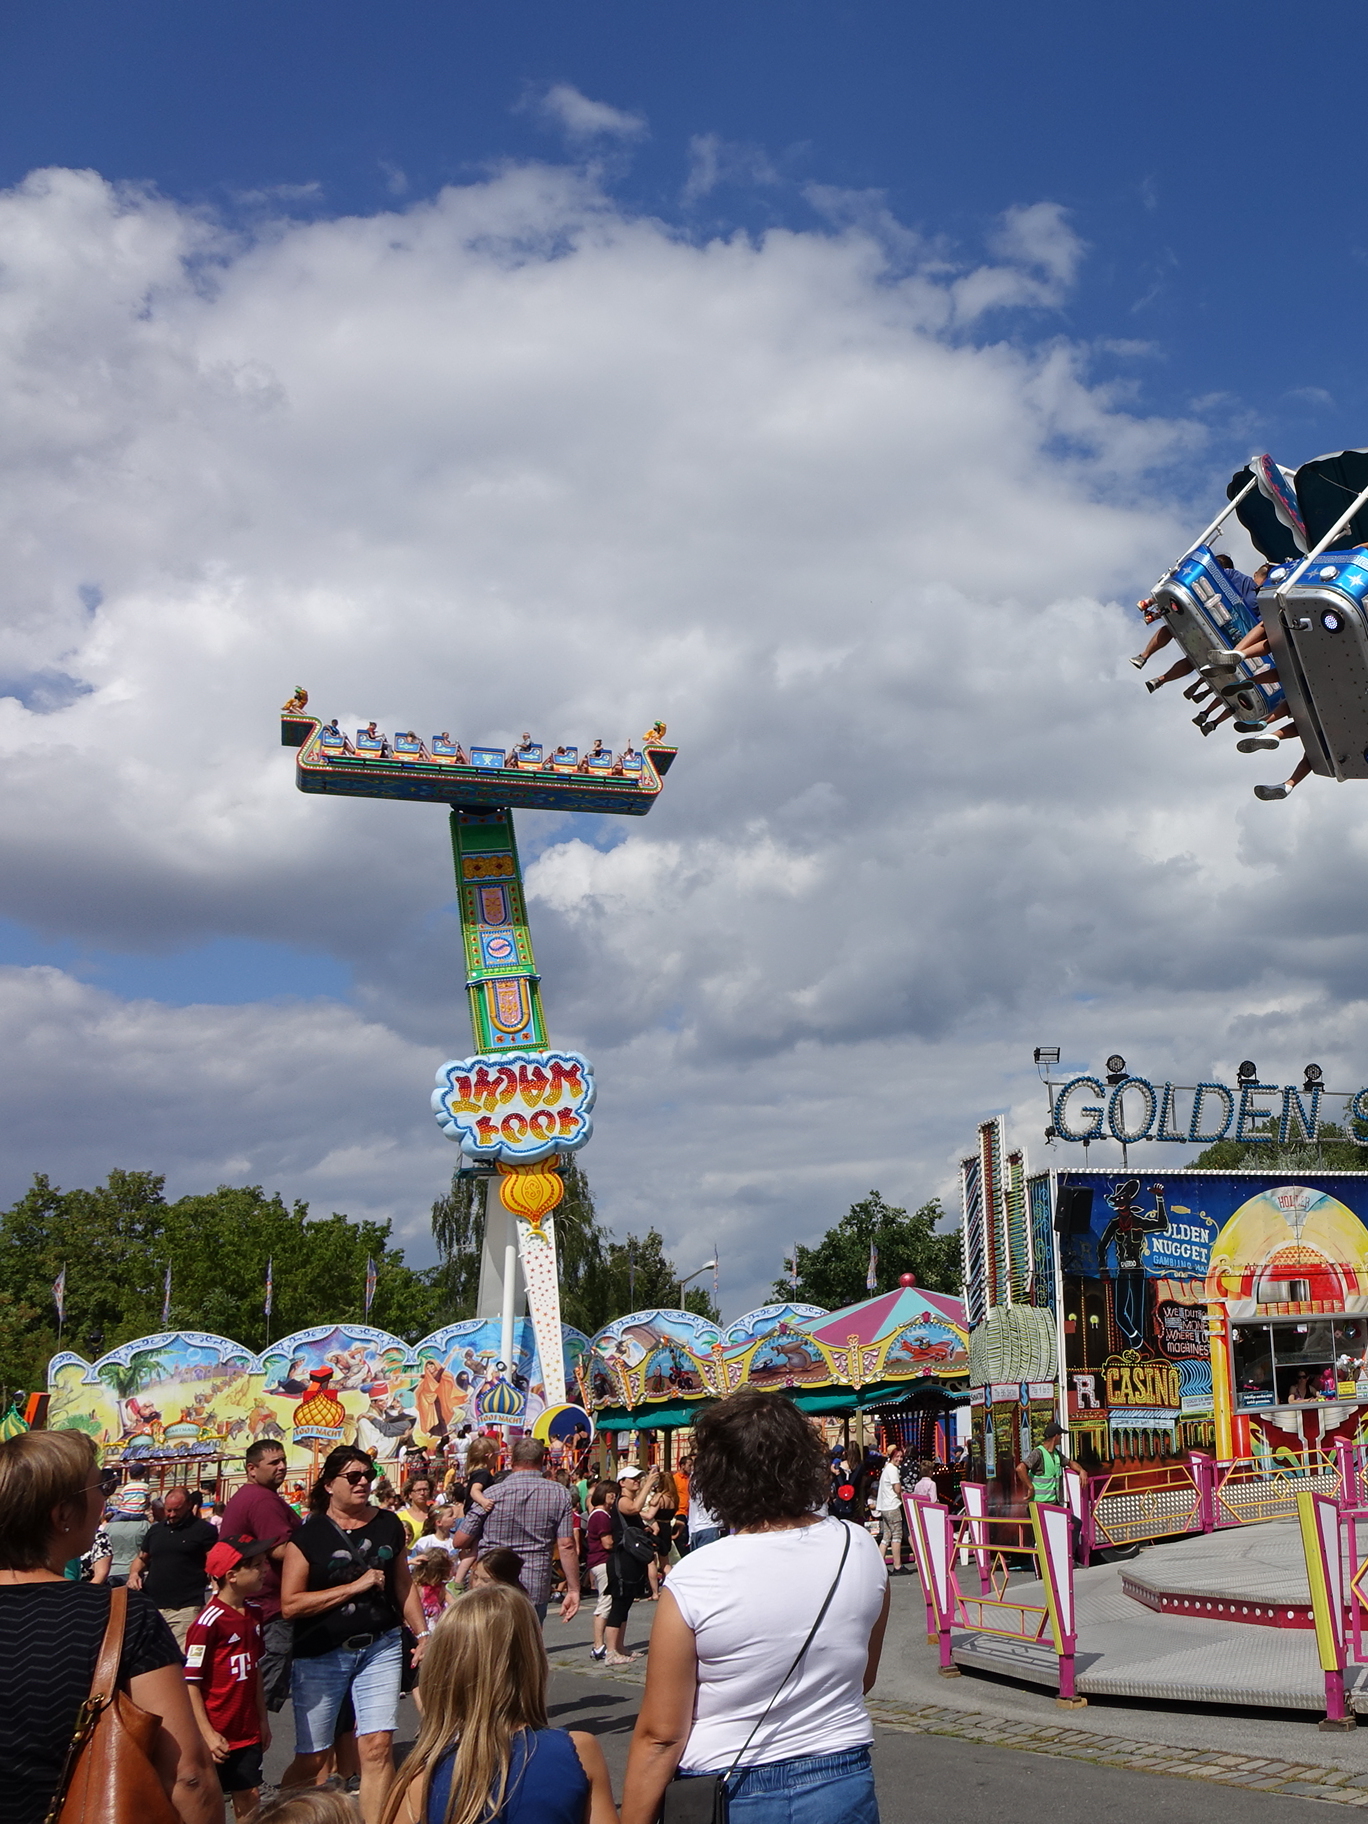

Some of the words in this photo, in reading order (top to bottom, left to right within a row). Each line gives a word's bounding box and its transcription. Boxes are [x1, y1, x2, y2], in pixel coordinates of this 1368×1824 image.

[450, 1060, 584, 1115] NACHT
[476, 1107, 580, 1145] 1001
[1053, 1075, 1323, 1145] GOLDEN
[1151, 1237, 1208, 1263] NUGGET
[1154, 1222, 1210, 1244] OLDEN
[1182, 1321, 1208, 1331] MONE
[1106, 1367, 1180, 1406] CASINO
